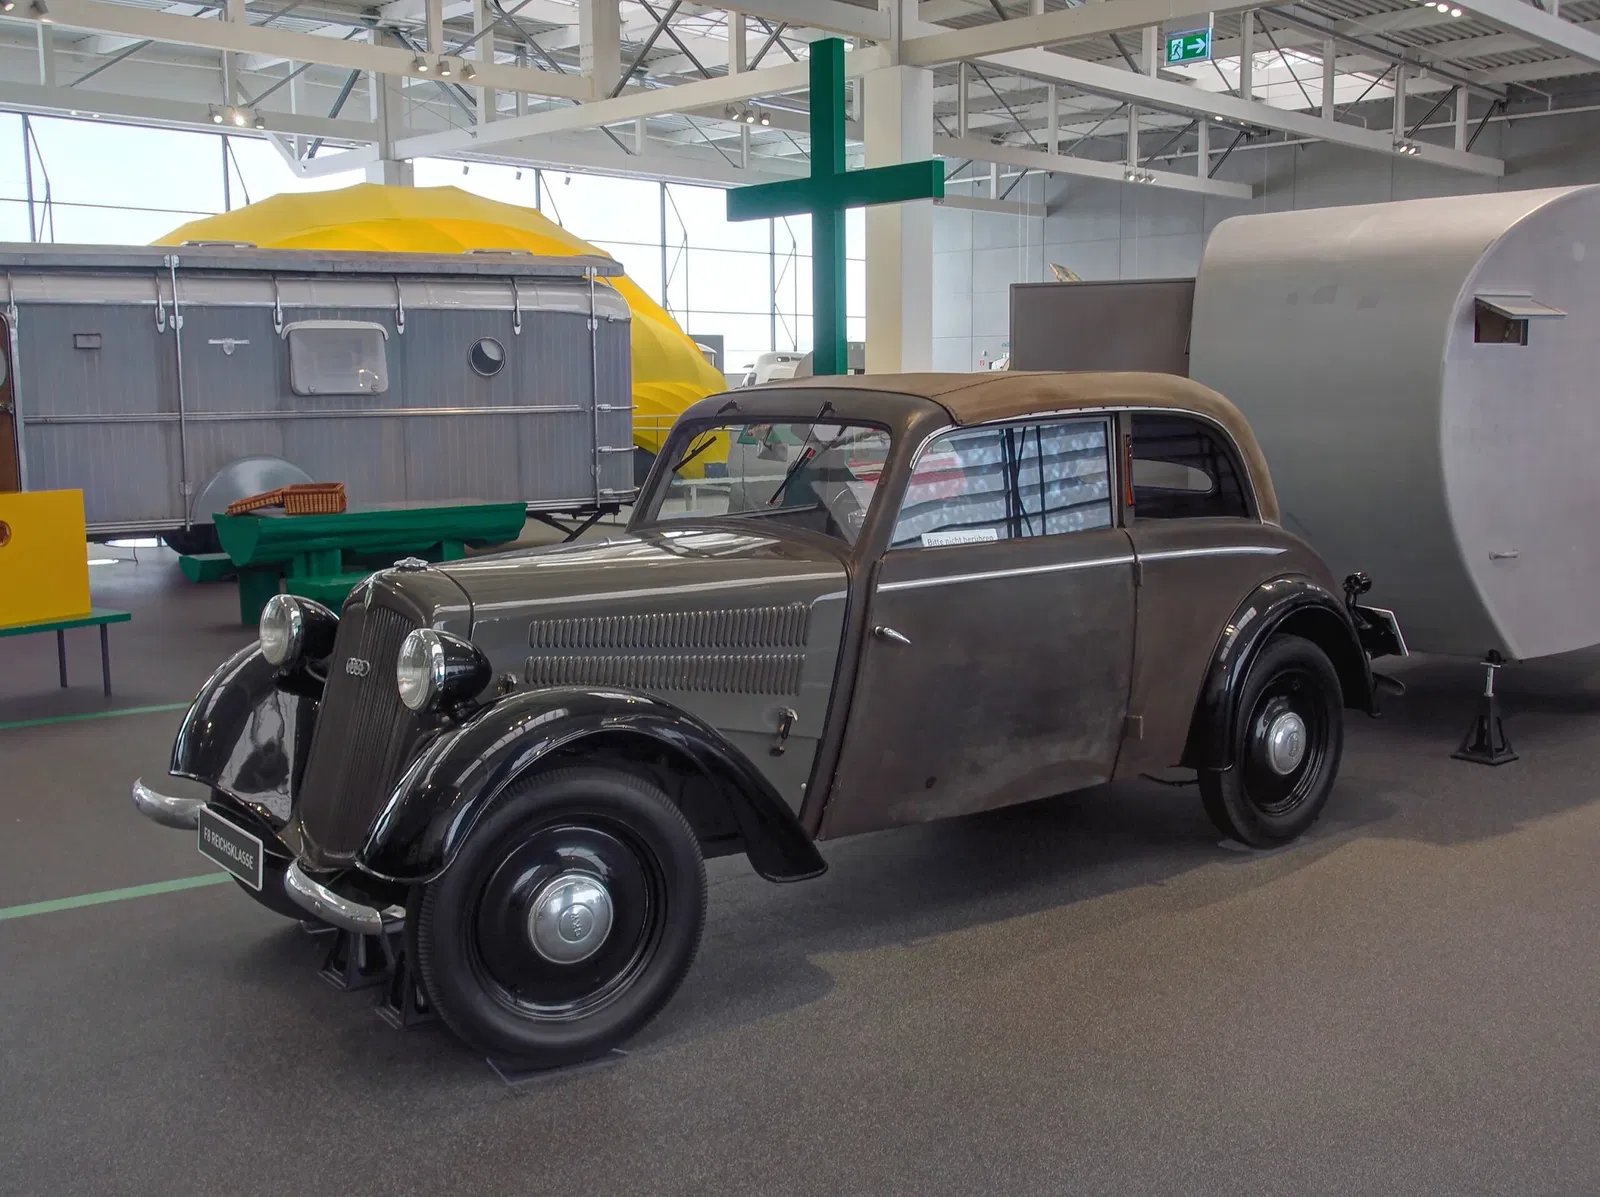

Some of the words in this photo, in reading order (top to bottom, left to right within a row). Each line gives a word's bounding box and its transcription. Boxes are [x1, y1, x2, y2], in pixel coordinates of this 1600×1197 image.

[927, 537, 944, 546] Bitte
[945, 536, 962, 545] nicht
[203, 826, 211, 843] F8
[211, 831, 254, 870] REICHSKLASSE
